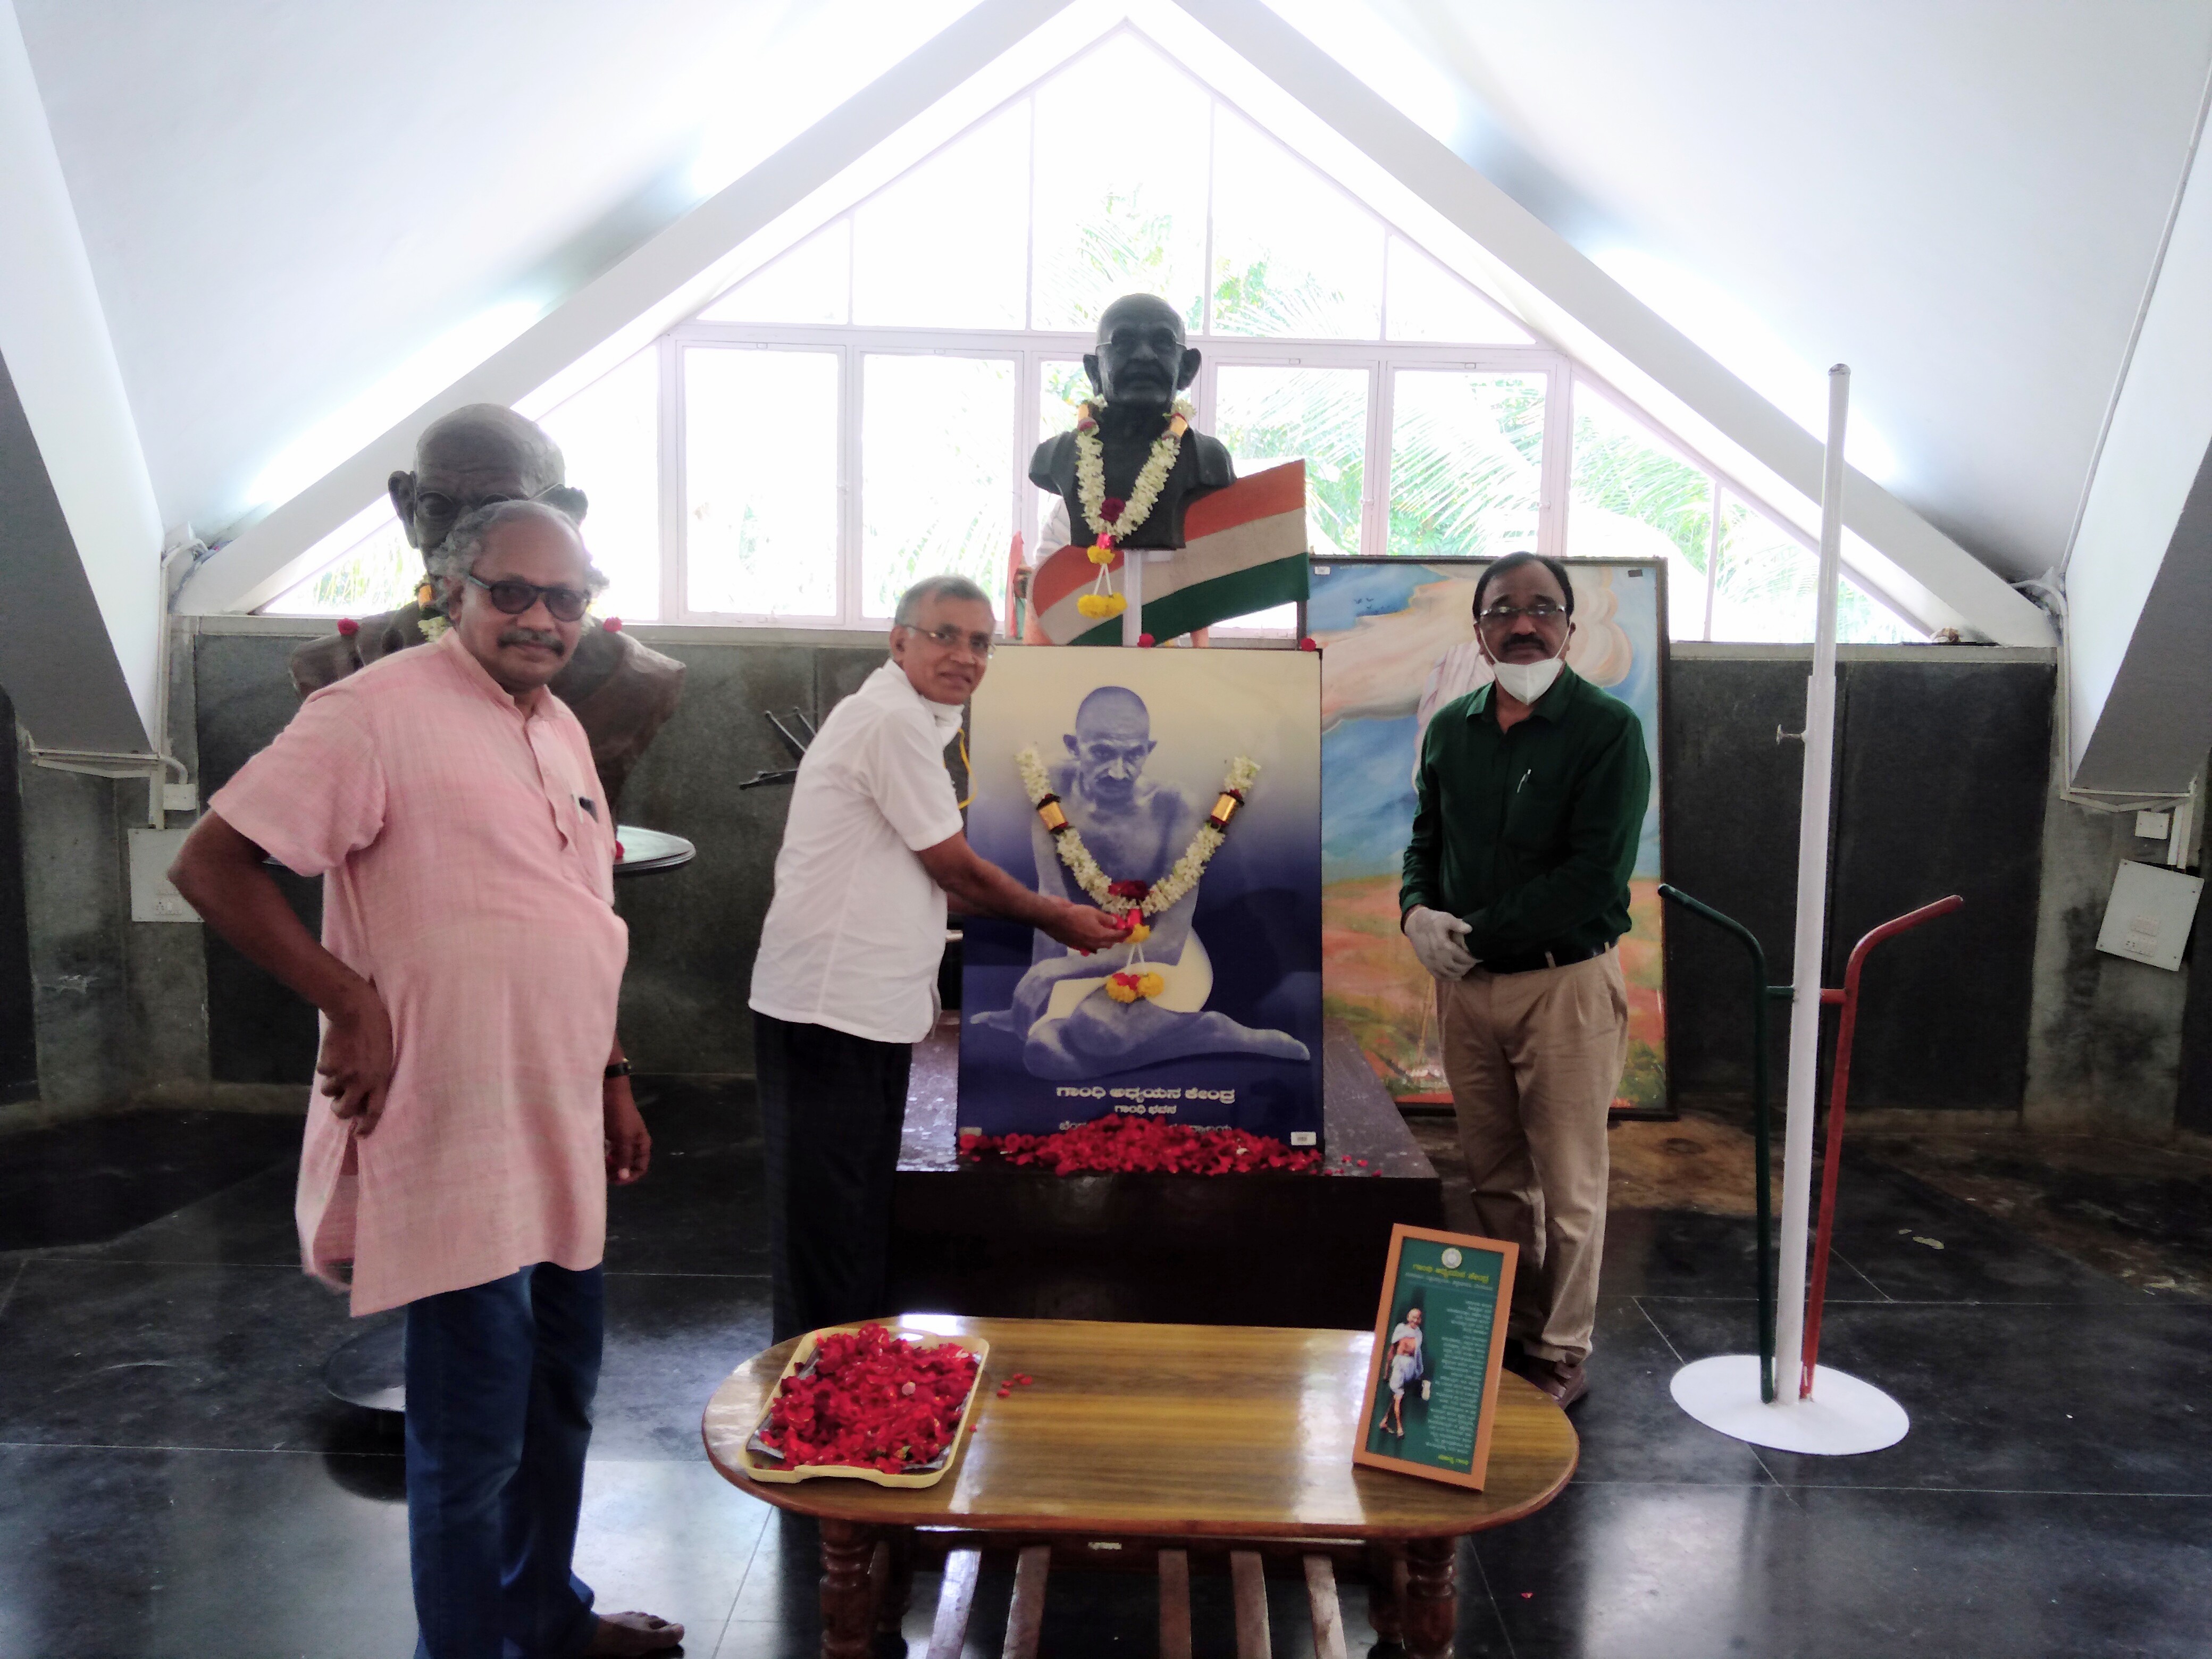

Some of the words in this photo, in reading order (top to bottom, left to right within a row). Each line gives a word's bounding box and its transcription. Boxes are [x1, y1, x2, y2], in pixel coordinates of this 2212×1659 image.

[1057, 1086, 1106, 1100] ಗಾಂಧಿ
[1110, 1086, 1182, 1103] ಅಧ್ಯಯನ
[1185, 1087, 1235, 1104] ಕೇಂದ್ರ
[1115, 1104, 1146, 1115] ಗಾಂಧಿ
